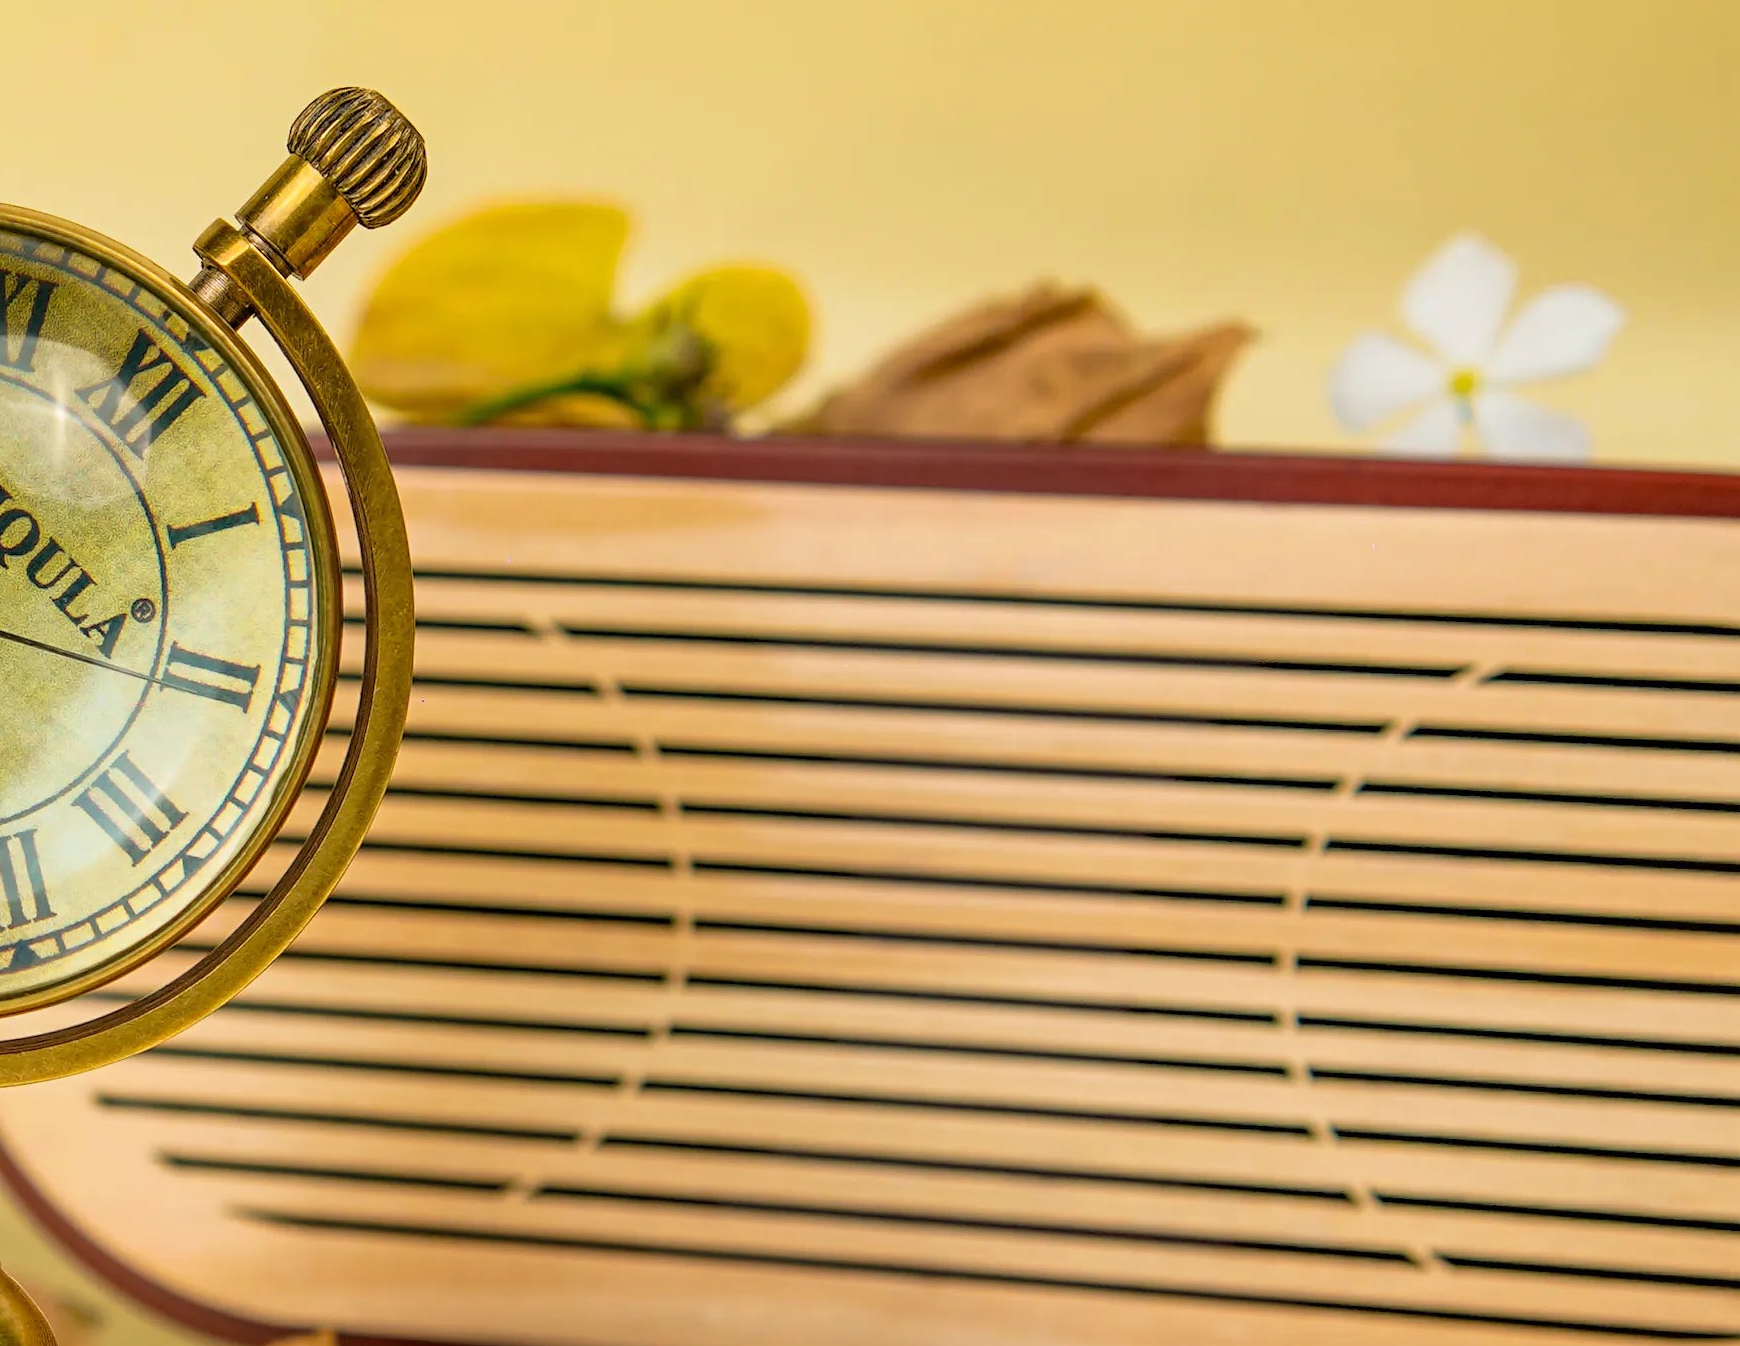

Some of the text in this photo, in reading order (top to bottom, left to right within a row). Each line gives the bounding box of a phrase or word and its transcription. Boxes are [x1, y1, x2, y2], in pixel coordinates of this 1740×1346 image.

[75, 327, 208, 461] XII
[166, 502, 261, 550] I
[160, 640, 262, 715] II
[71, 749, 190, 868] III
